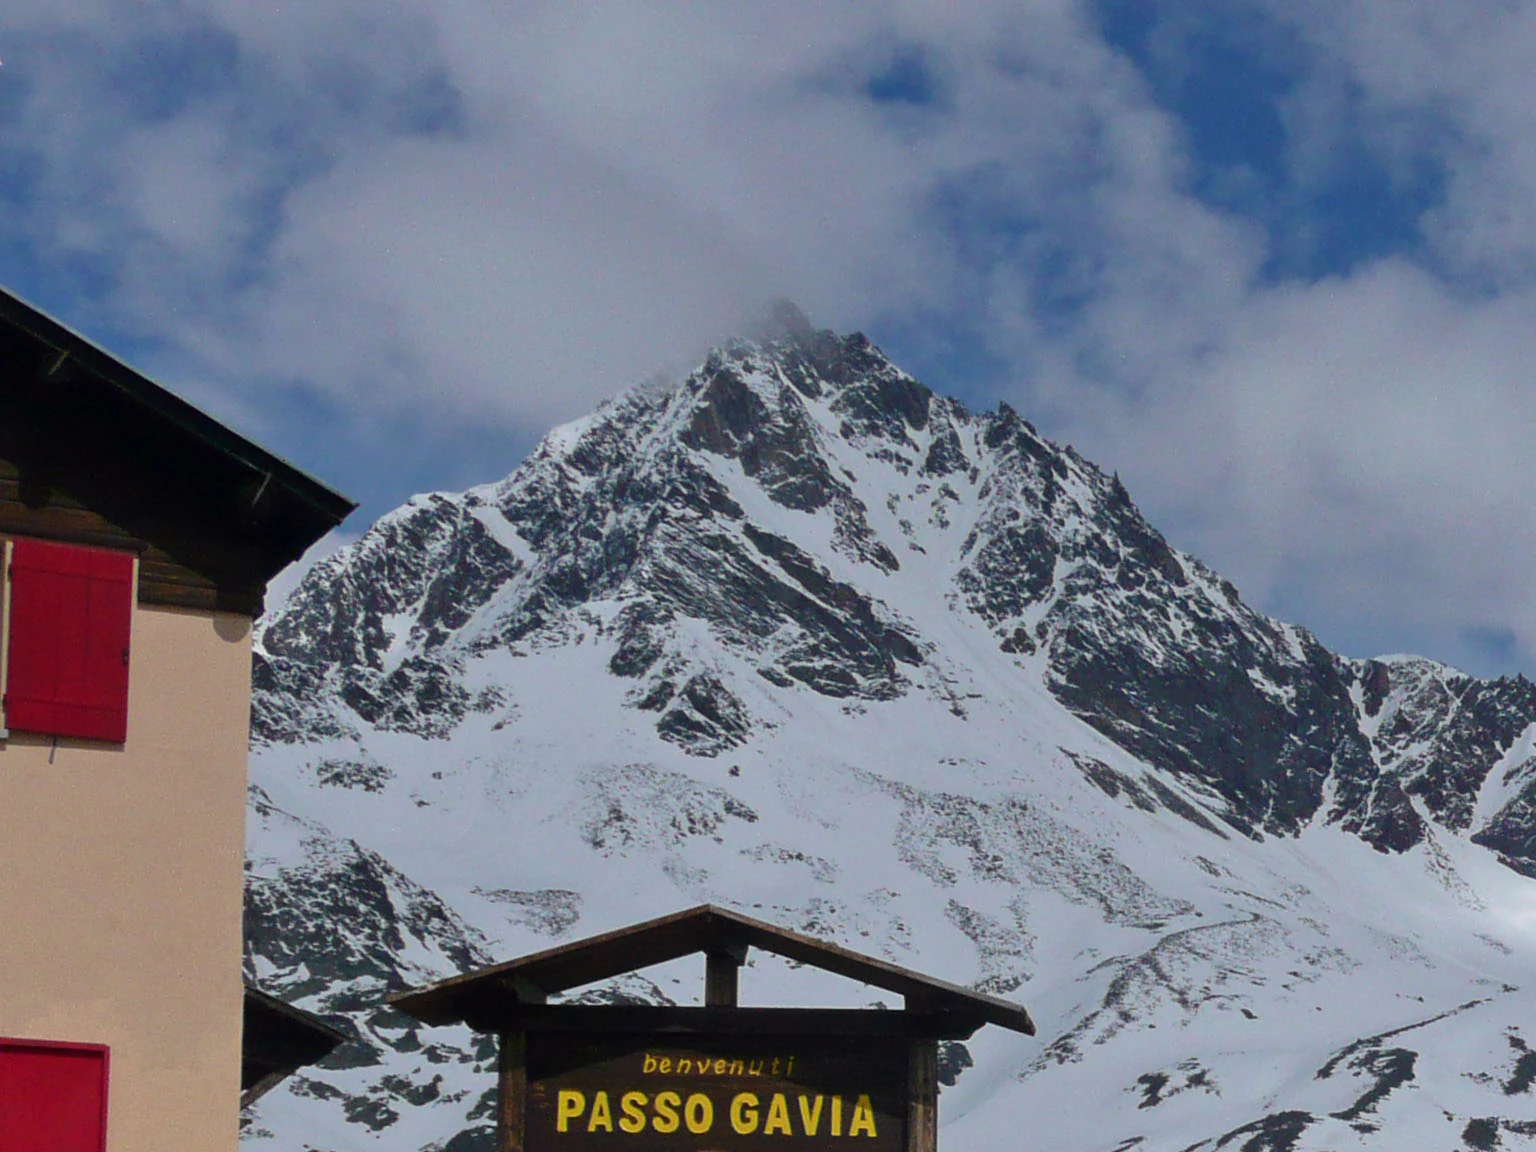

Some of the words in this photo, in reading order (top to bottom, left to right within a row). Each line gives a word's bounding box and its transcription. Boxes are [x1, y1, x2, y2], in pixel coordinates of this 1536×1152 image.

[643, 1053, 796, 1077] benvenuti
[556, 1089, 714, 1135] PASSO
[730, 1092, 878, 1138] GAVIA
